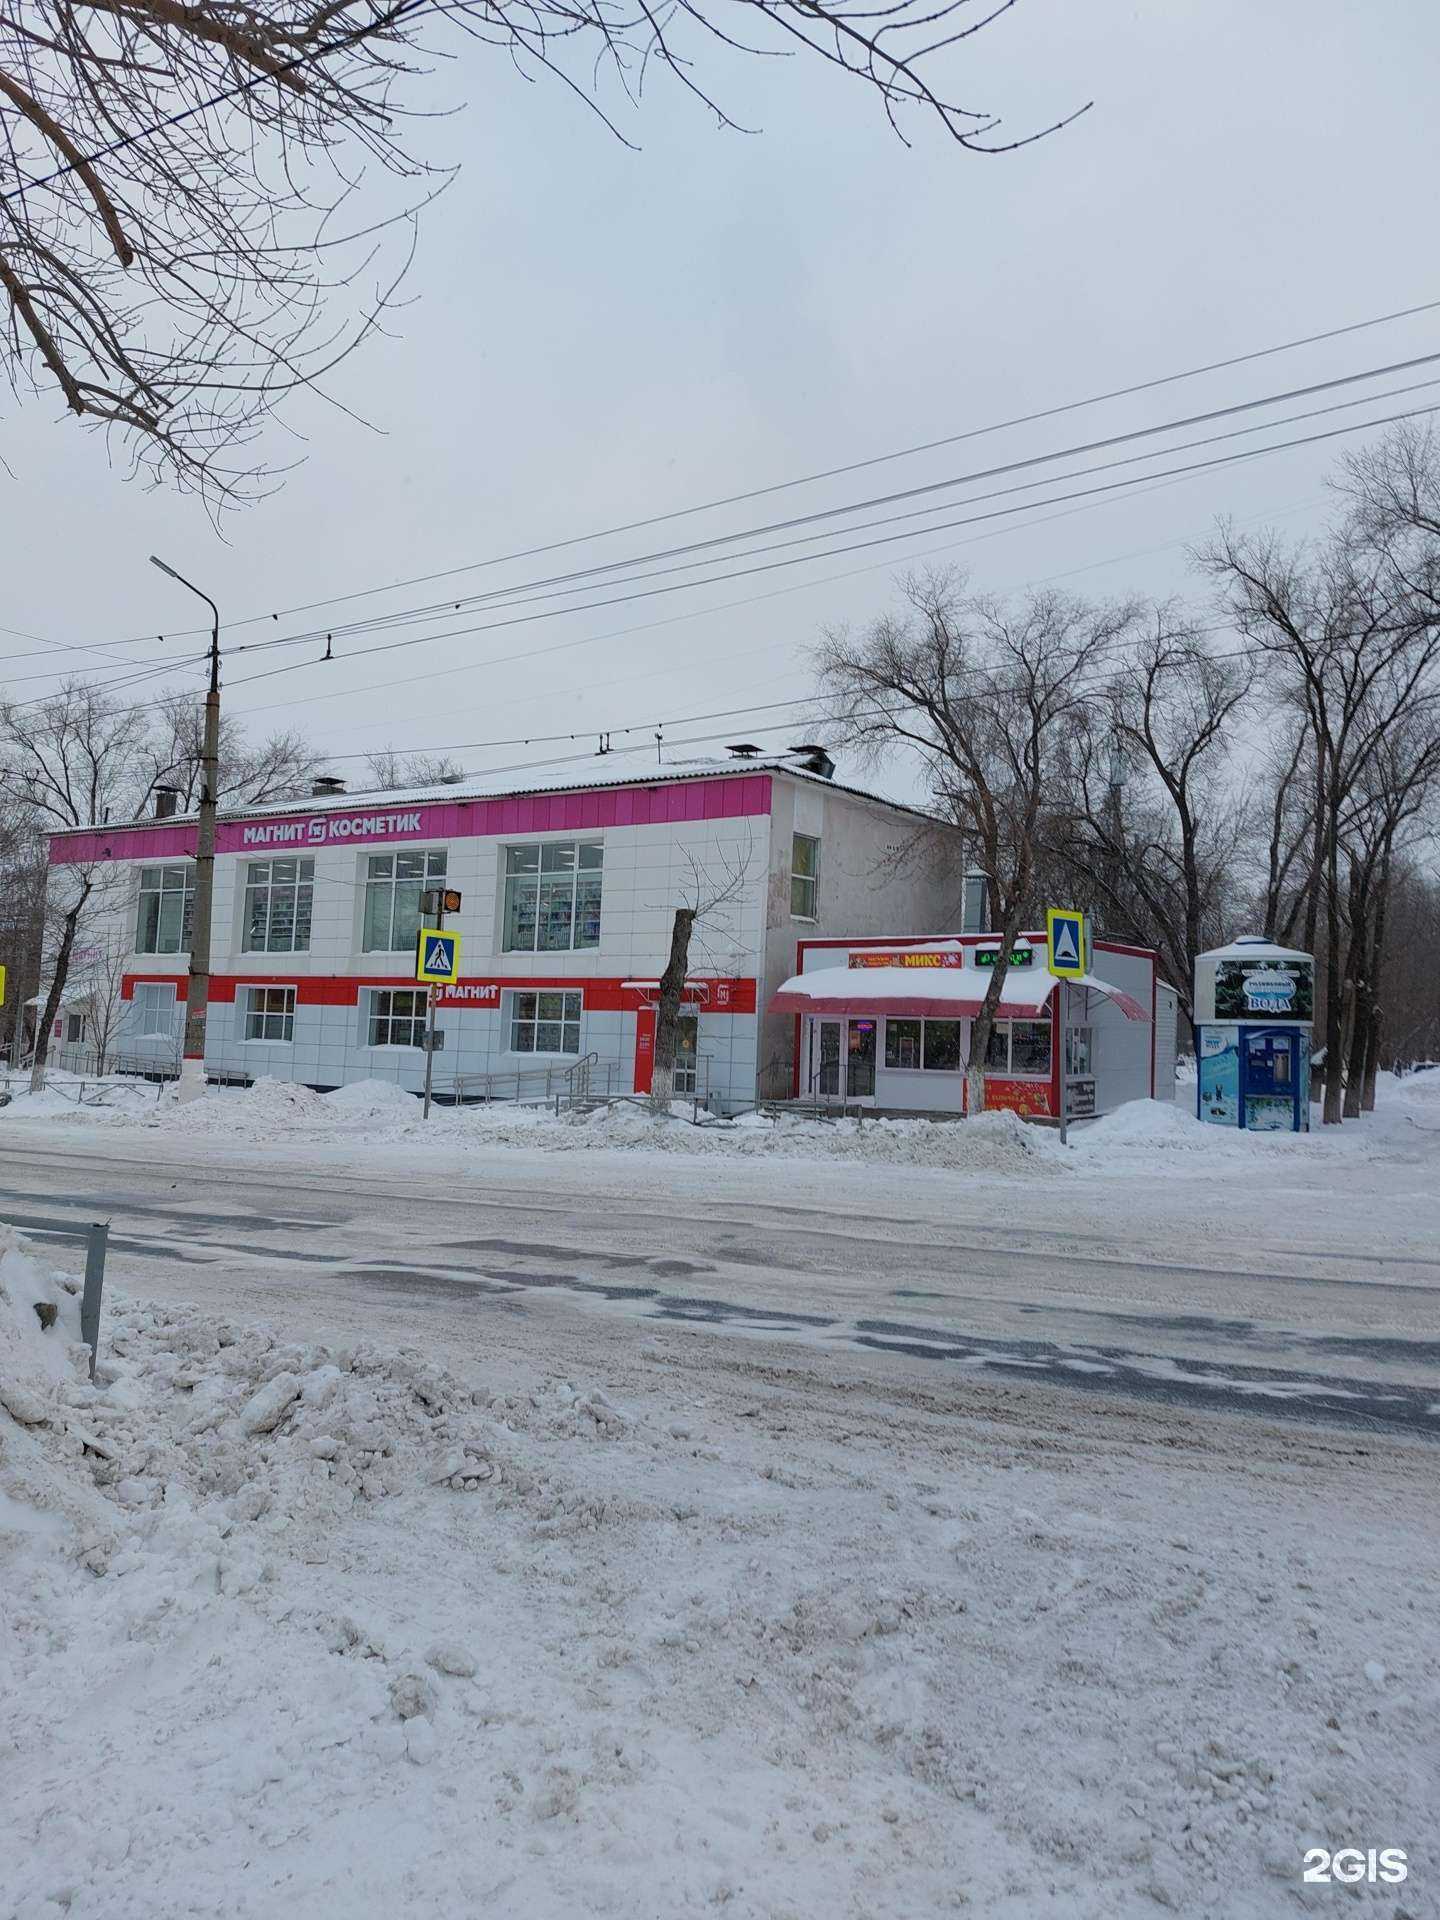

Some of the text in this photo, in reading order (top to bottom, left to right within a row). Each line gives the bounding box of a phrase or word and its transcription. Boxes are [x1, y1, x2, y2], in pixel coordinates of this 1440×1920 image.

[243, 813, 421, 844] МАГНИТ КОСМЕТИК
[904, 954, 942, 967] МИКС
[445, 984, 498, 999] МАГНИТ
[1250, 997, 1291, 1011] ВОДА
